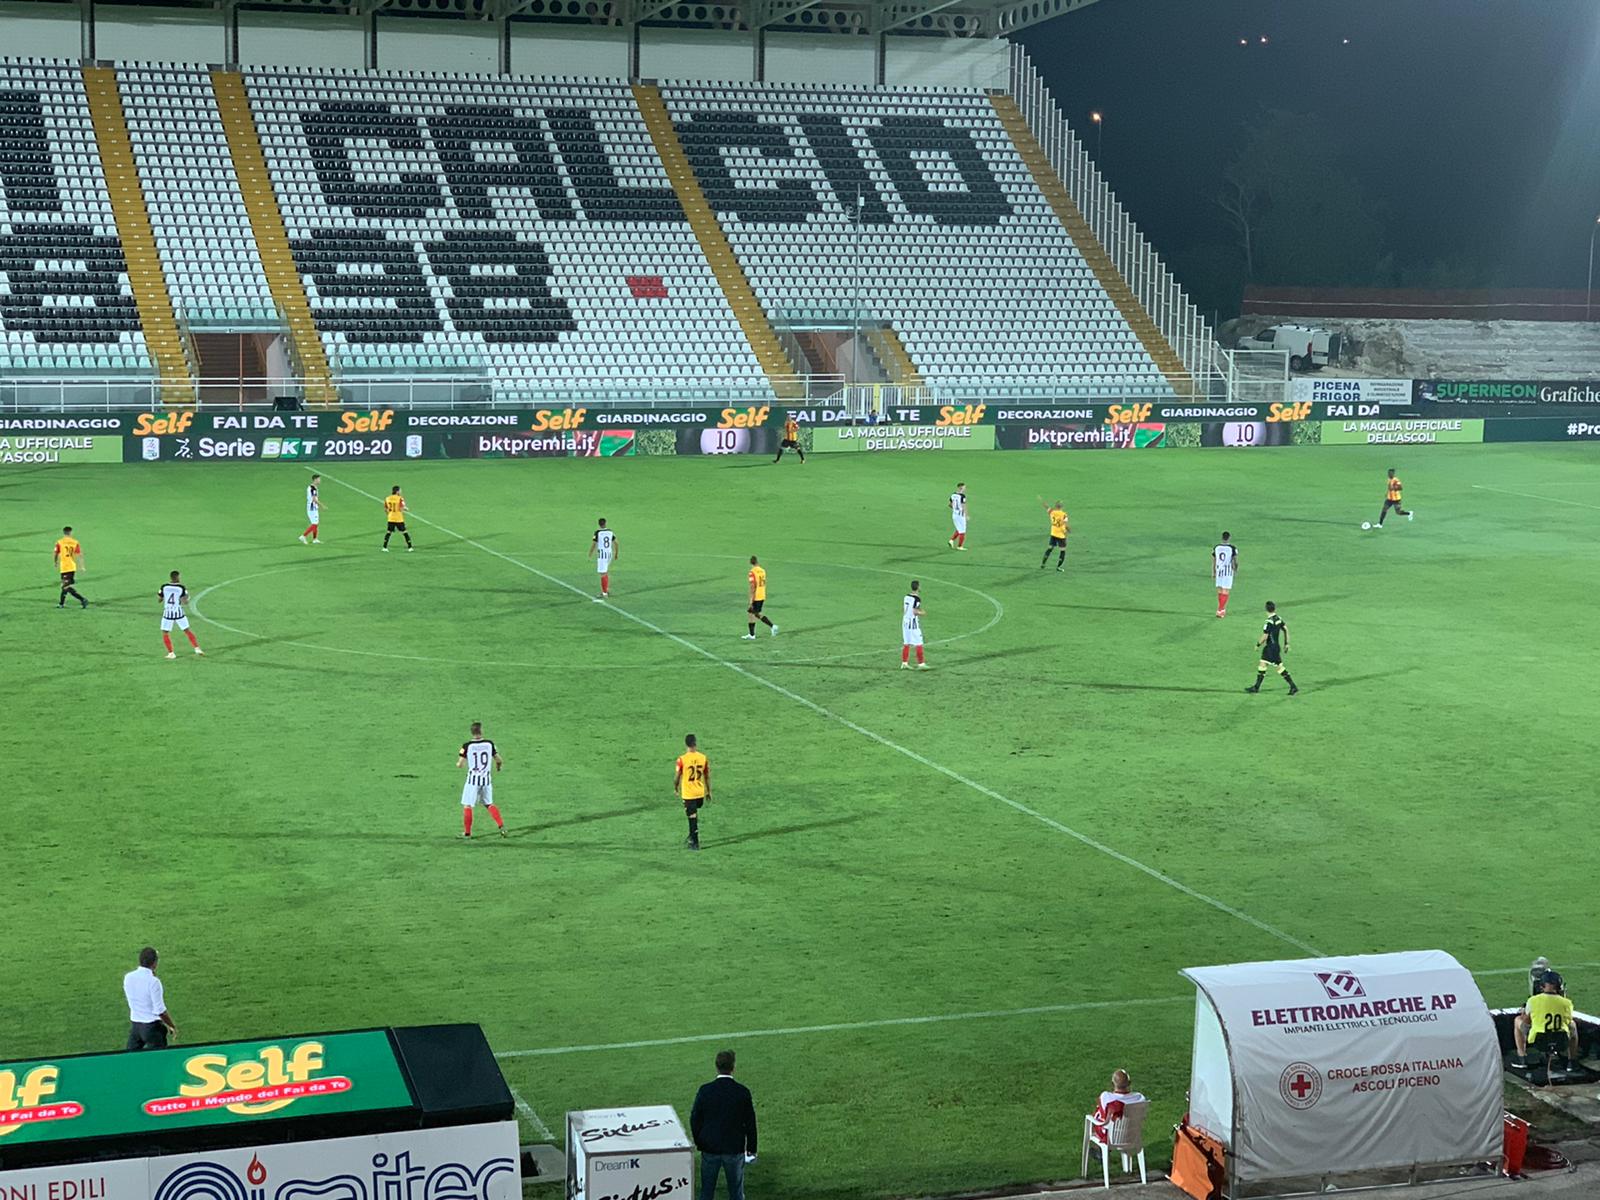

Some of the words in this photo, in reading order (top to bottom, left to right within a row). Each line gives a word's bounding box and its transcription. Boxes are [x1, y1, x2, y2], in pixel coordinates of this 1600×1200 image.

[1313, 381, 1361, 391] PICENA
[1437, 383, 1537, 398] SUPERNEON
[1312, 392, 1361, 401] FRIGOR
[132, 411, 194, 436] Self
[213, 416, 248, 429] FAI
[254, 416, 286, 428] DA
[291, 416, 319, 428] TE
[336, 409, 394, 434] Self
[408, 415, 519, 426] DECORAZIONE
[531, 408, 587, 432] Self
[596, 413, 708, 424] GIARDINAGGIO
[716, 406, 770, 429] Self
[896, 409, 921, 422] TE
[935, 404, 987, 427] Self
[997, 409, 1094, 420] DECORAZIONE
[1104, 403, 1153, 425] Self
[1161, 407, 1258, 418] GIARDINAGGIO
[1266, 401, 1313, 423] Self
[1326, 405, 1354, 417] FAI
[838, 428, 854, 439] LA
[858, 427, 905, 438] MAGLIA
[909, 426, 972, 438] UFFICIALE
[1235, 424, 1255, 443] 10
[1343, 422, 1357, 432] LA
[1360, 421, 1402, 431] MAGLIA
[1405, 420, 1462, 431] UFFICIALE
[15, 437, 93, 449] UFFICIALE
[479, 434, 596, 456] bktpremia.it
[716, 430, 737, 450] 10
[866, 439, 944, 451] DELL'ASCOLI
[1028, 428, 1131, 447] bktpremia.it
[1367, 432, 1437, 443] DELL'ASCOLI
[198, 437, 256, 458] Serie
[261, 438, 321, 458] BKT
[324, 439, 393, 456] 2019-20
[603, 537, 610, 548] 8
[167, 593, 176, 605] 4
[471, 752, 489, 772] 19
[687, 765, 704, 782] 25
[1251, 996, 1424, 1027] ELETTROMARCHE
[1431, 994, 1457, 1010] AP
[1283, 1023, 1324, 1034] IMPIANTI
[1326, 1020, 1369, 1032] ELETTRICI
[1370, 1018, 1376, 1028] E
[1378, 1014, 1438, 1028] TECNOLOGICI
[1544, 1013, 1562, 1031] 20
[179, 1042, 323, 1098] Self
[1327, 1065, 1368, 1080] CROCE
[1371, 1062, 1409, 1075] ROSSA
[1412, 1058, 1464, 1071] ITALIANA
[1352, 1078, 1394, 1093] ASCOLI
[1398, 1074, 1440, 1088] PICENO
[151, 1102, 187, 1112] Tutto
[191, 1099, 200, 1107] il
[205, 1093, 253, 1105] Mondo
[257, 1089, 279, 1098] del
[284, 1086, 305, 1094] Fai
[309, 1083, 326, 1092] da
[330, 1081, 346, 1089] Te
[11, 1113, 33, 1121] Fai
[38, 1109, 56, 1117] da
[61, 1106, 78, 1114] Te
[48, 1177, 105, 1200] EDILI
